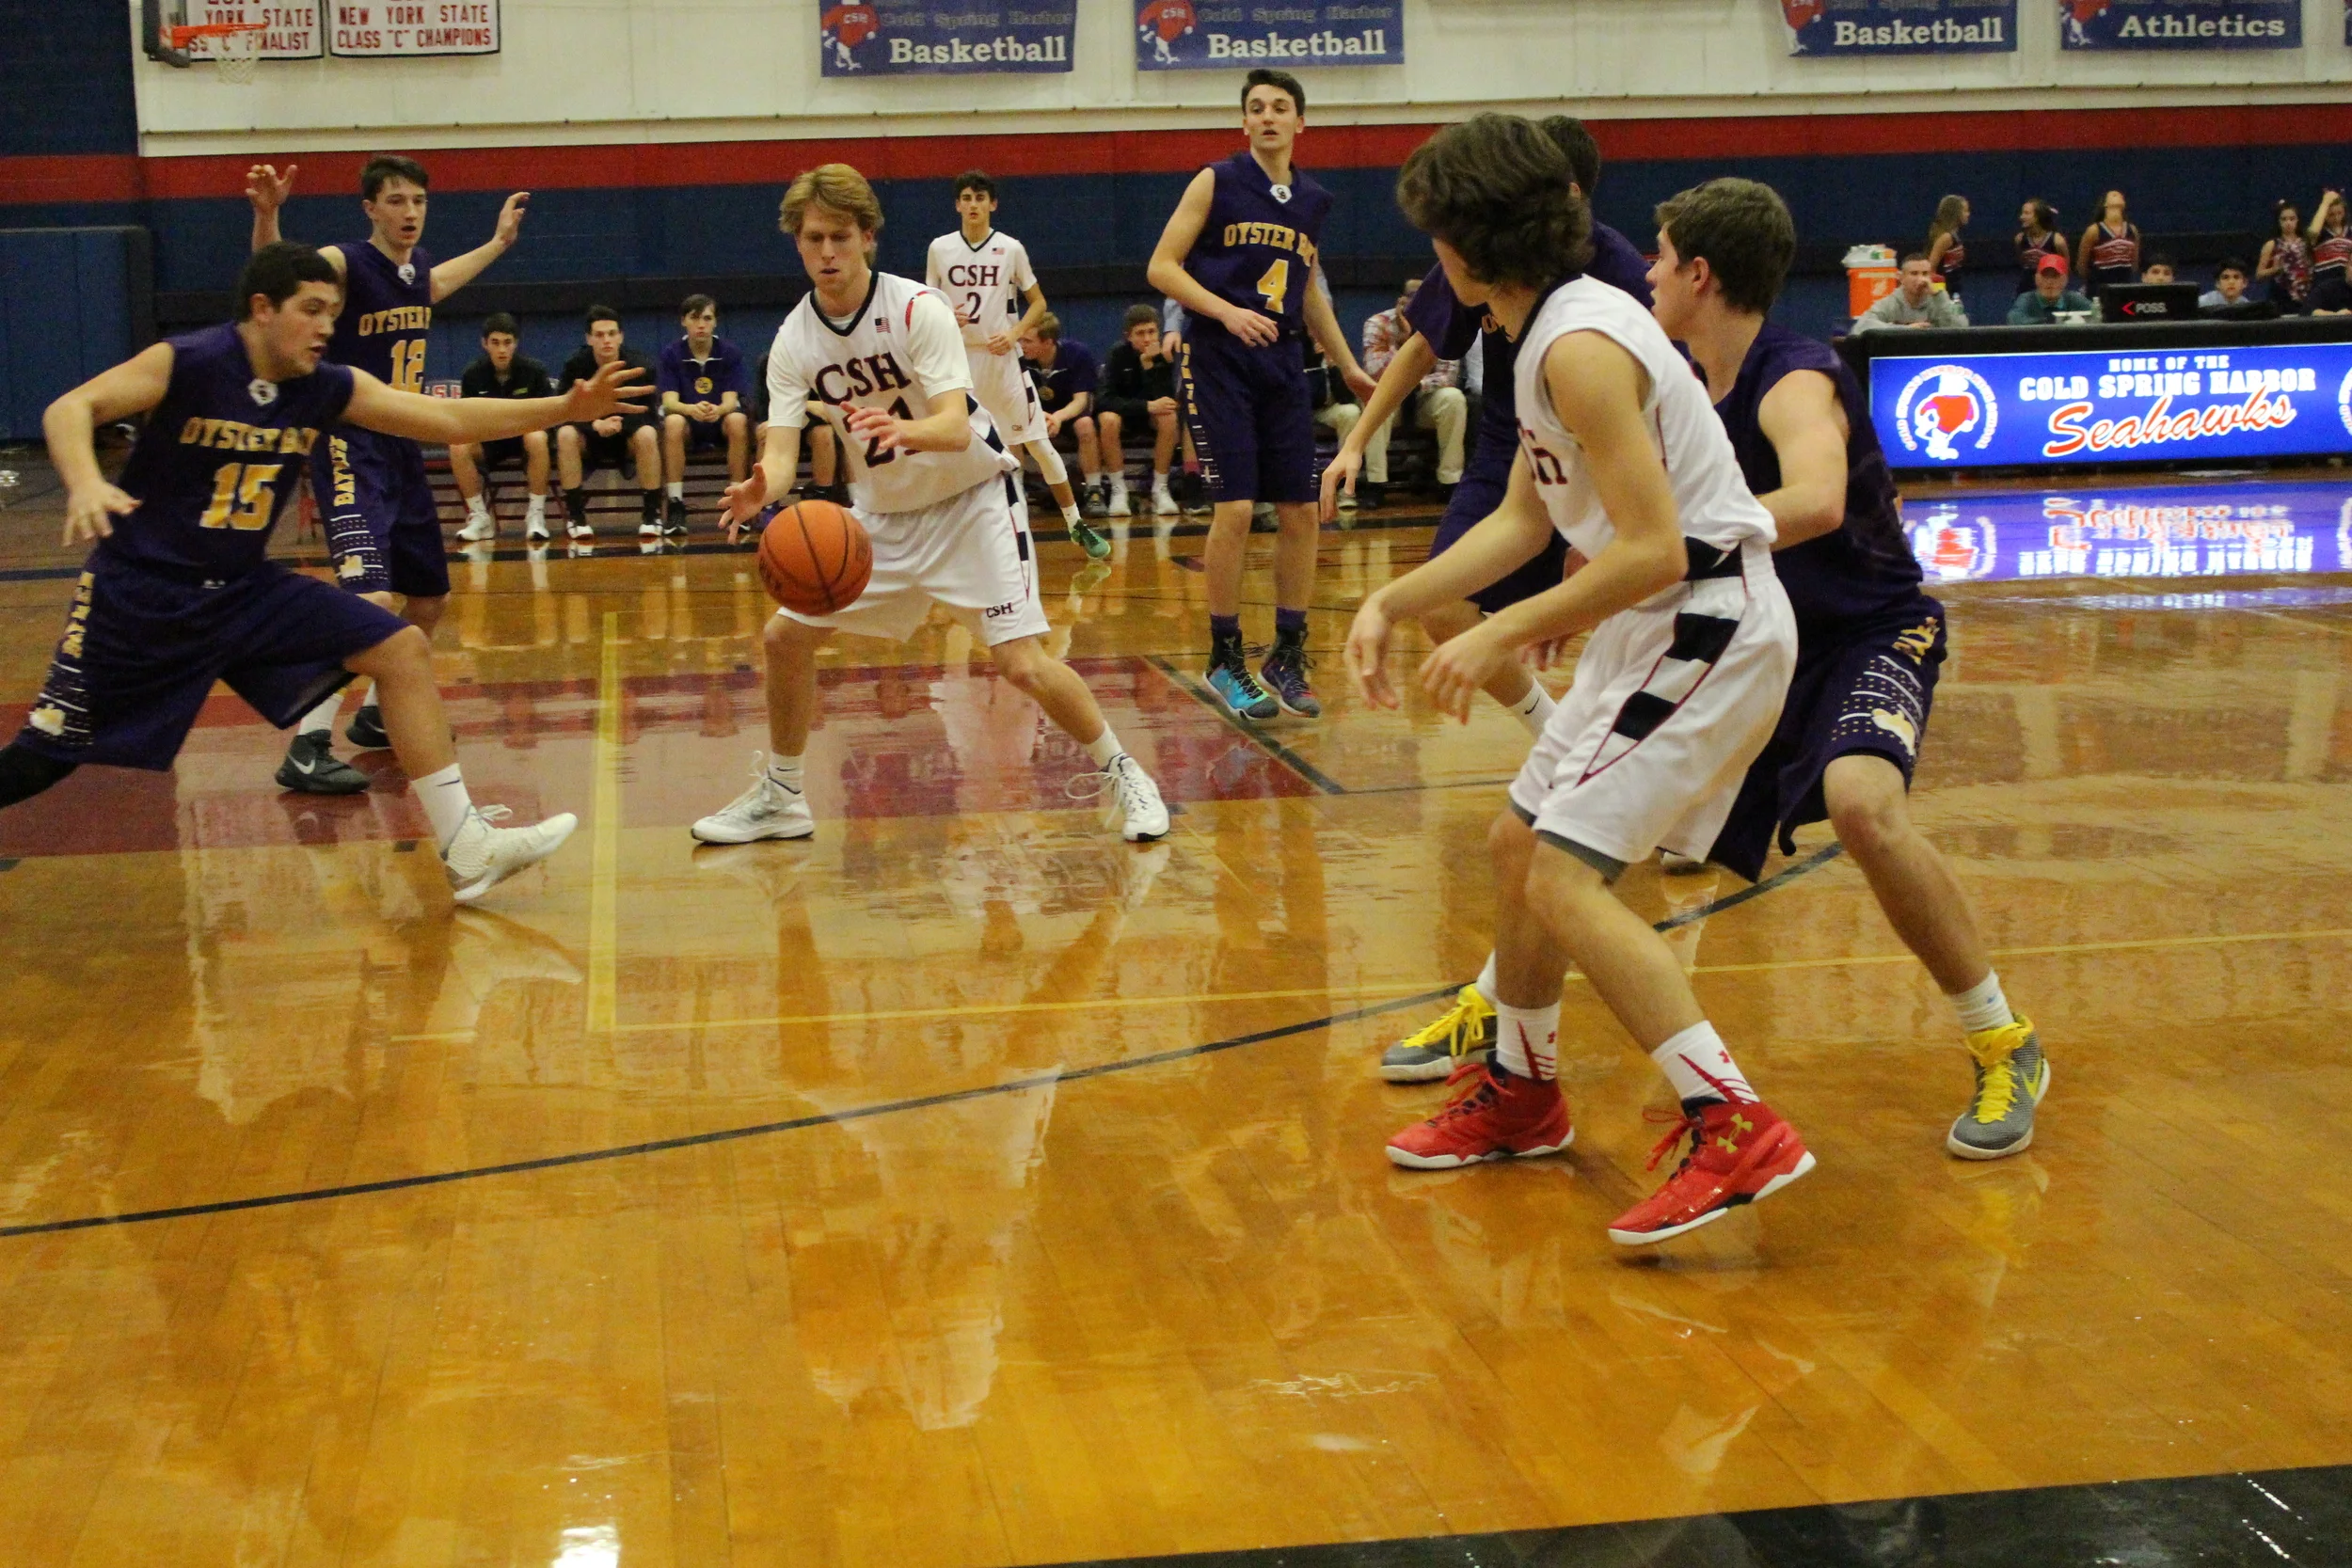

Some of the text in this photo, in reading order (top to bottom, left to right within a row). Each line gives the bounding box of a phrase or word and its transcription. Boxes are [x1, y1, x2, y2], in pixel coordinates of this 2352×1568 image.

[262, 8, 313, 27] STATE
[339, 5, 488, 24] NEW YORK STATE
[2118, 14, 2285, 38] Athletics
[337, 29, 381, 49] CLASS
[416, 27, 491, 47] CHAMPIONS
[1207, 29, 1387, 59] Basketball
[1836, 17, 2004, 46] Basketball
[889, 35, 1067, 64] Basketball
[1223, 221, 1296, 251] OYSTER
[947, 264, 1000, 287] CSH
[1256, 258, 1290, 314] 4
[966, 292, 981, 325] 2
[390, 339, 427, 395] 12
[815, 351, 912, 406] CSH
[2108, 355, 2230, 372] HOME OF THE
[2019, 368, 2316, 401] COLD SPRING HARBOR
[180, 416, 281, 452] OYSTER
[2042, 384, 2297, 458] Seahawks
[199, 462, 283, 531] 15
[986, 601, 1014, 619] CSH
